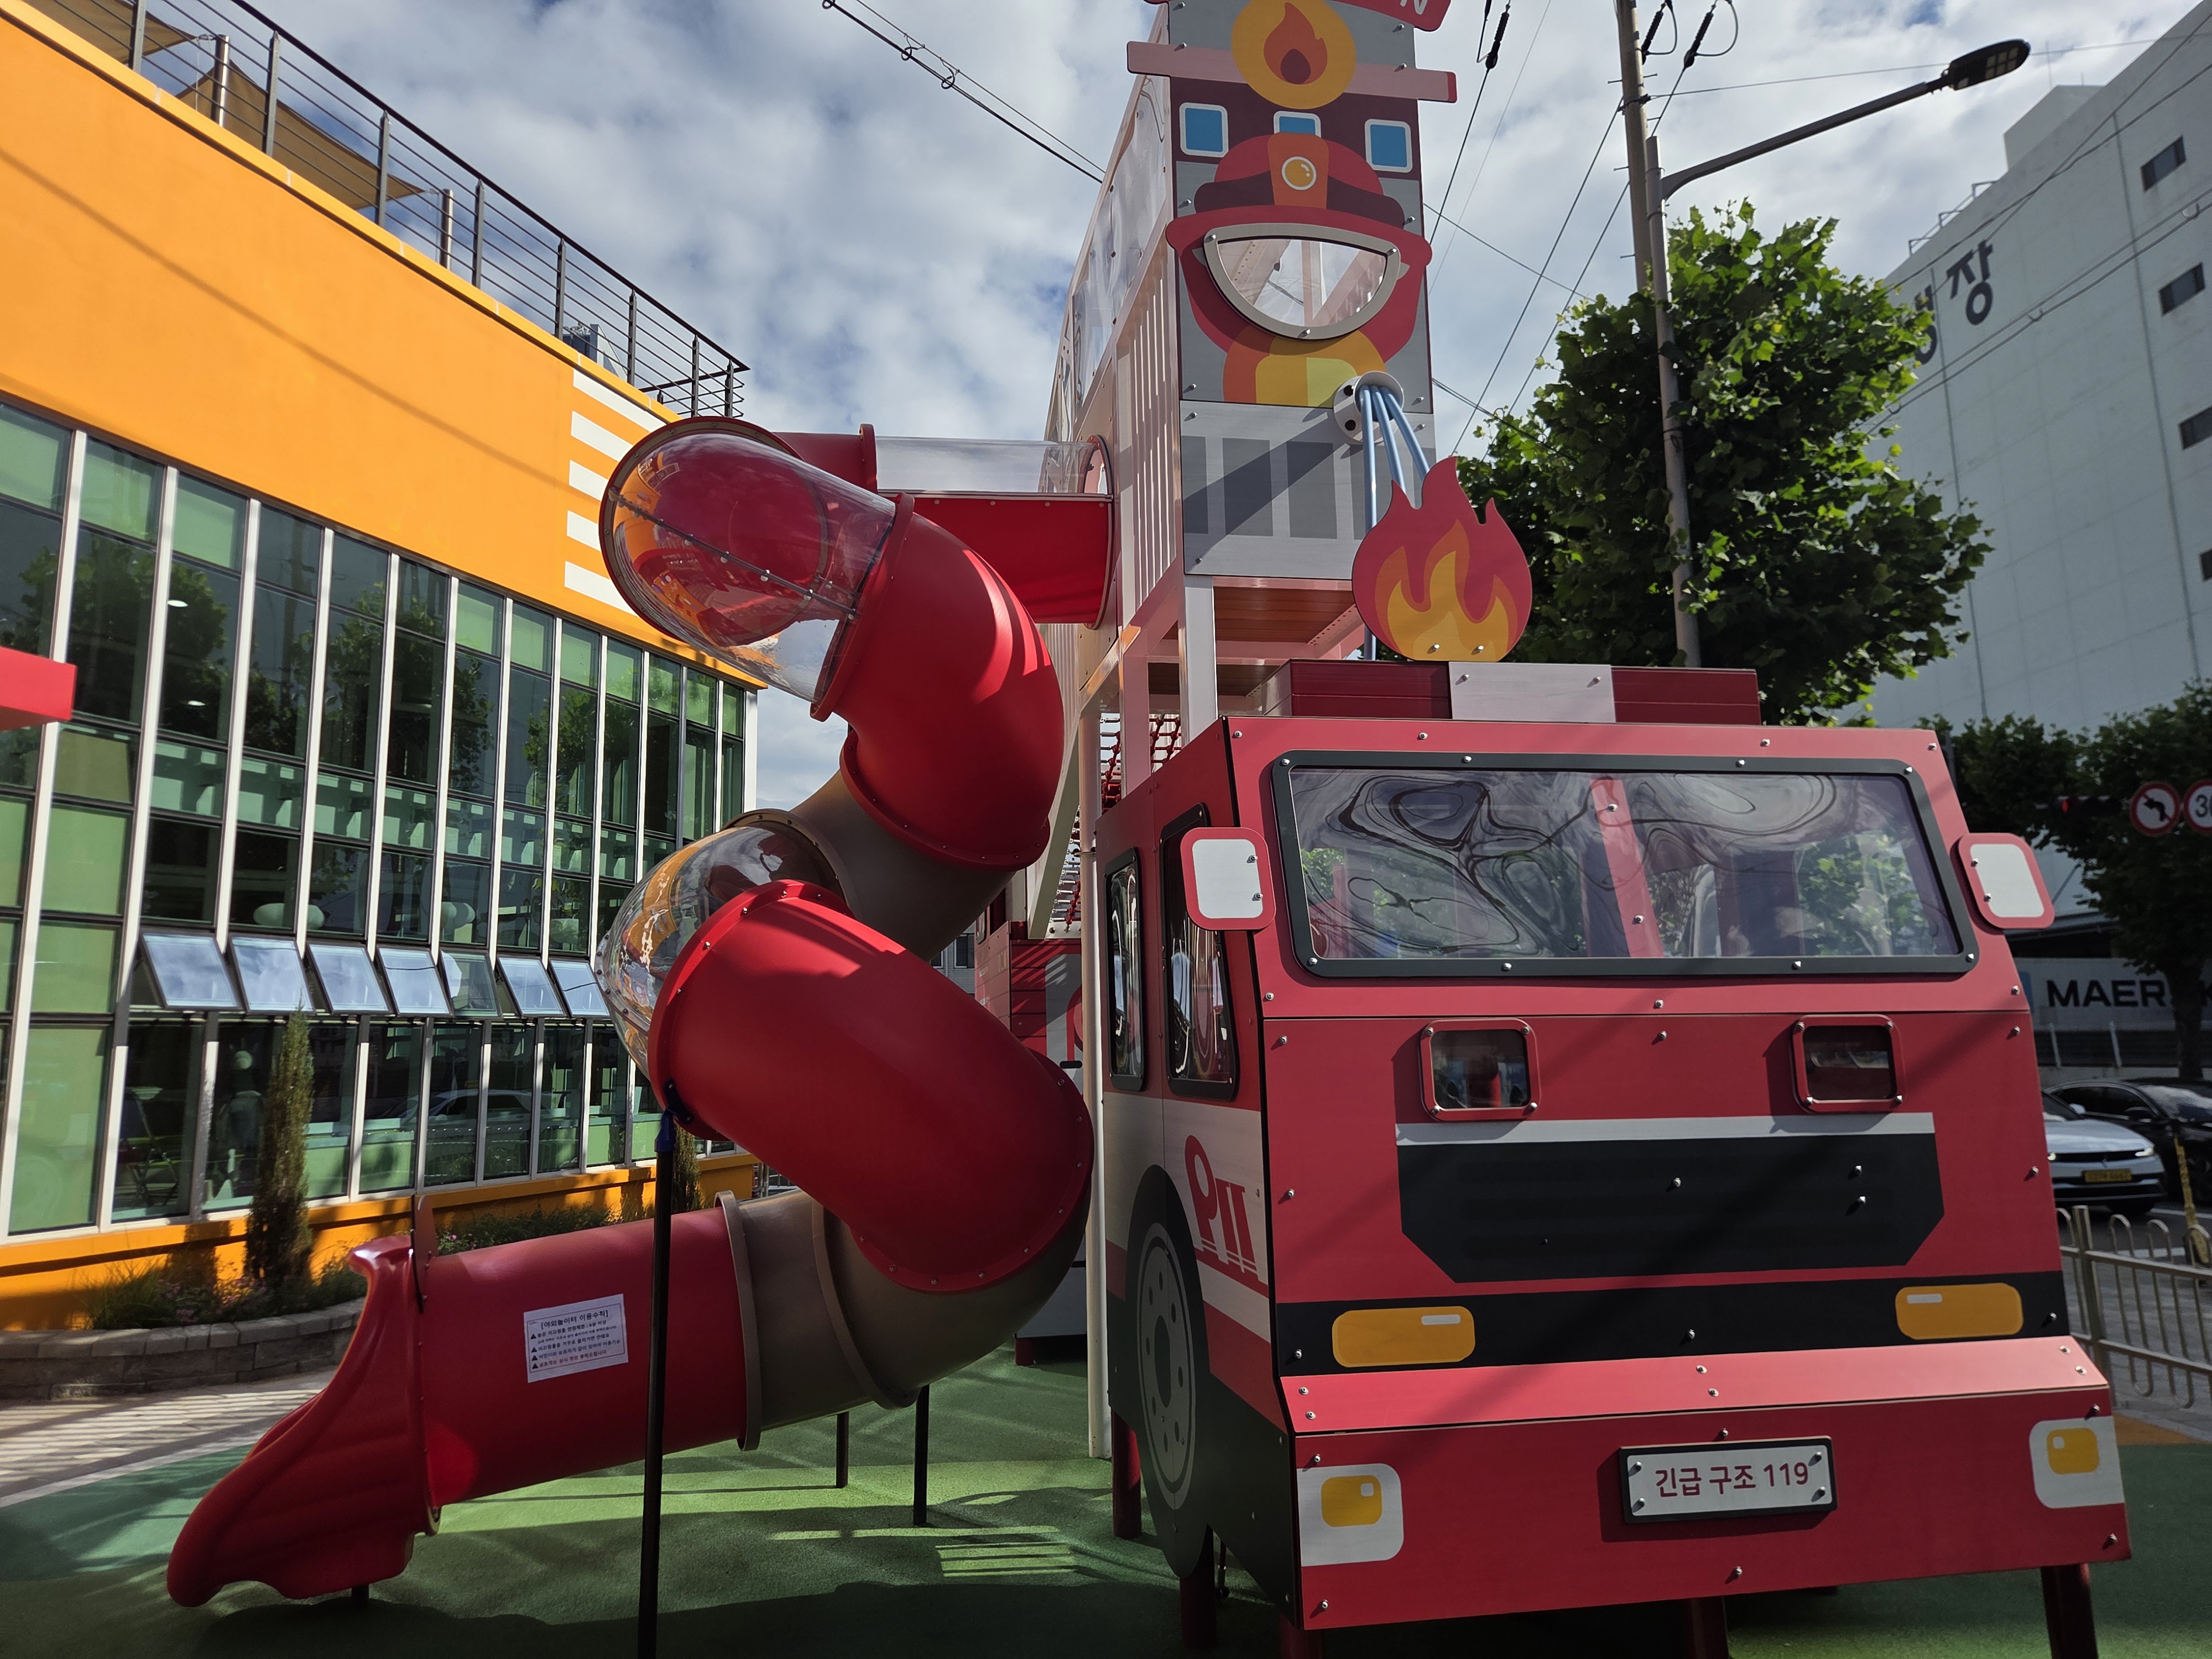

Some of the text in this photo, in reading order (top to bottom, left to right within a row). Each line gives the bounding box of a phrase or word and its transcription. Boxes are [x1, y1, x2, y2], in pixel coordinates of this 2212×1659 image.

[541, 1310, 608, 1330] [야외놀이터 이용수칙]
[1655, 1462, 1809, 1498] 긴급 구조 119
